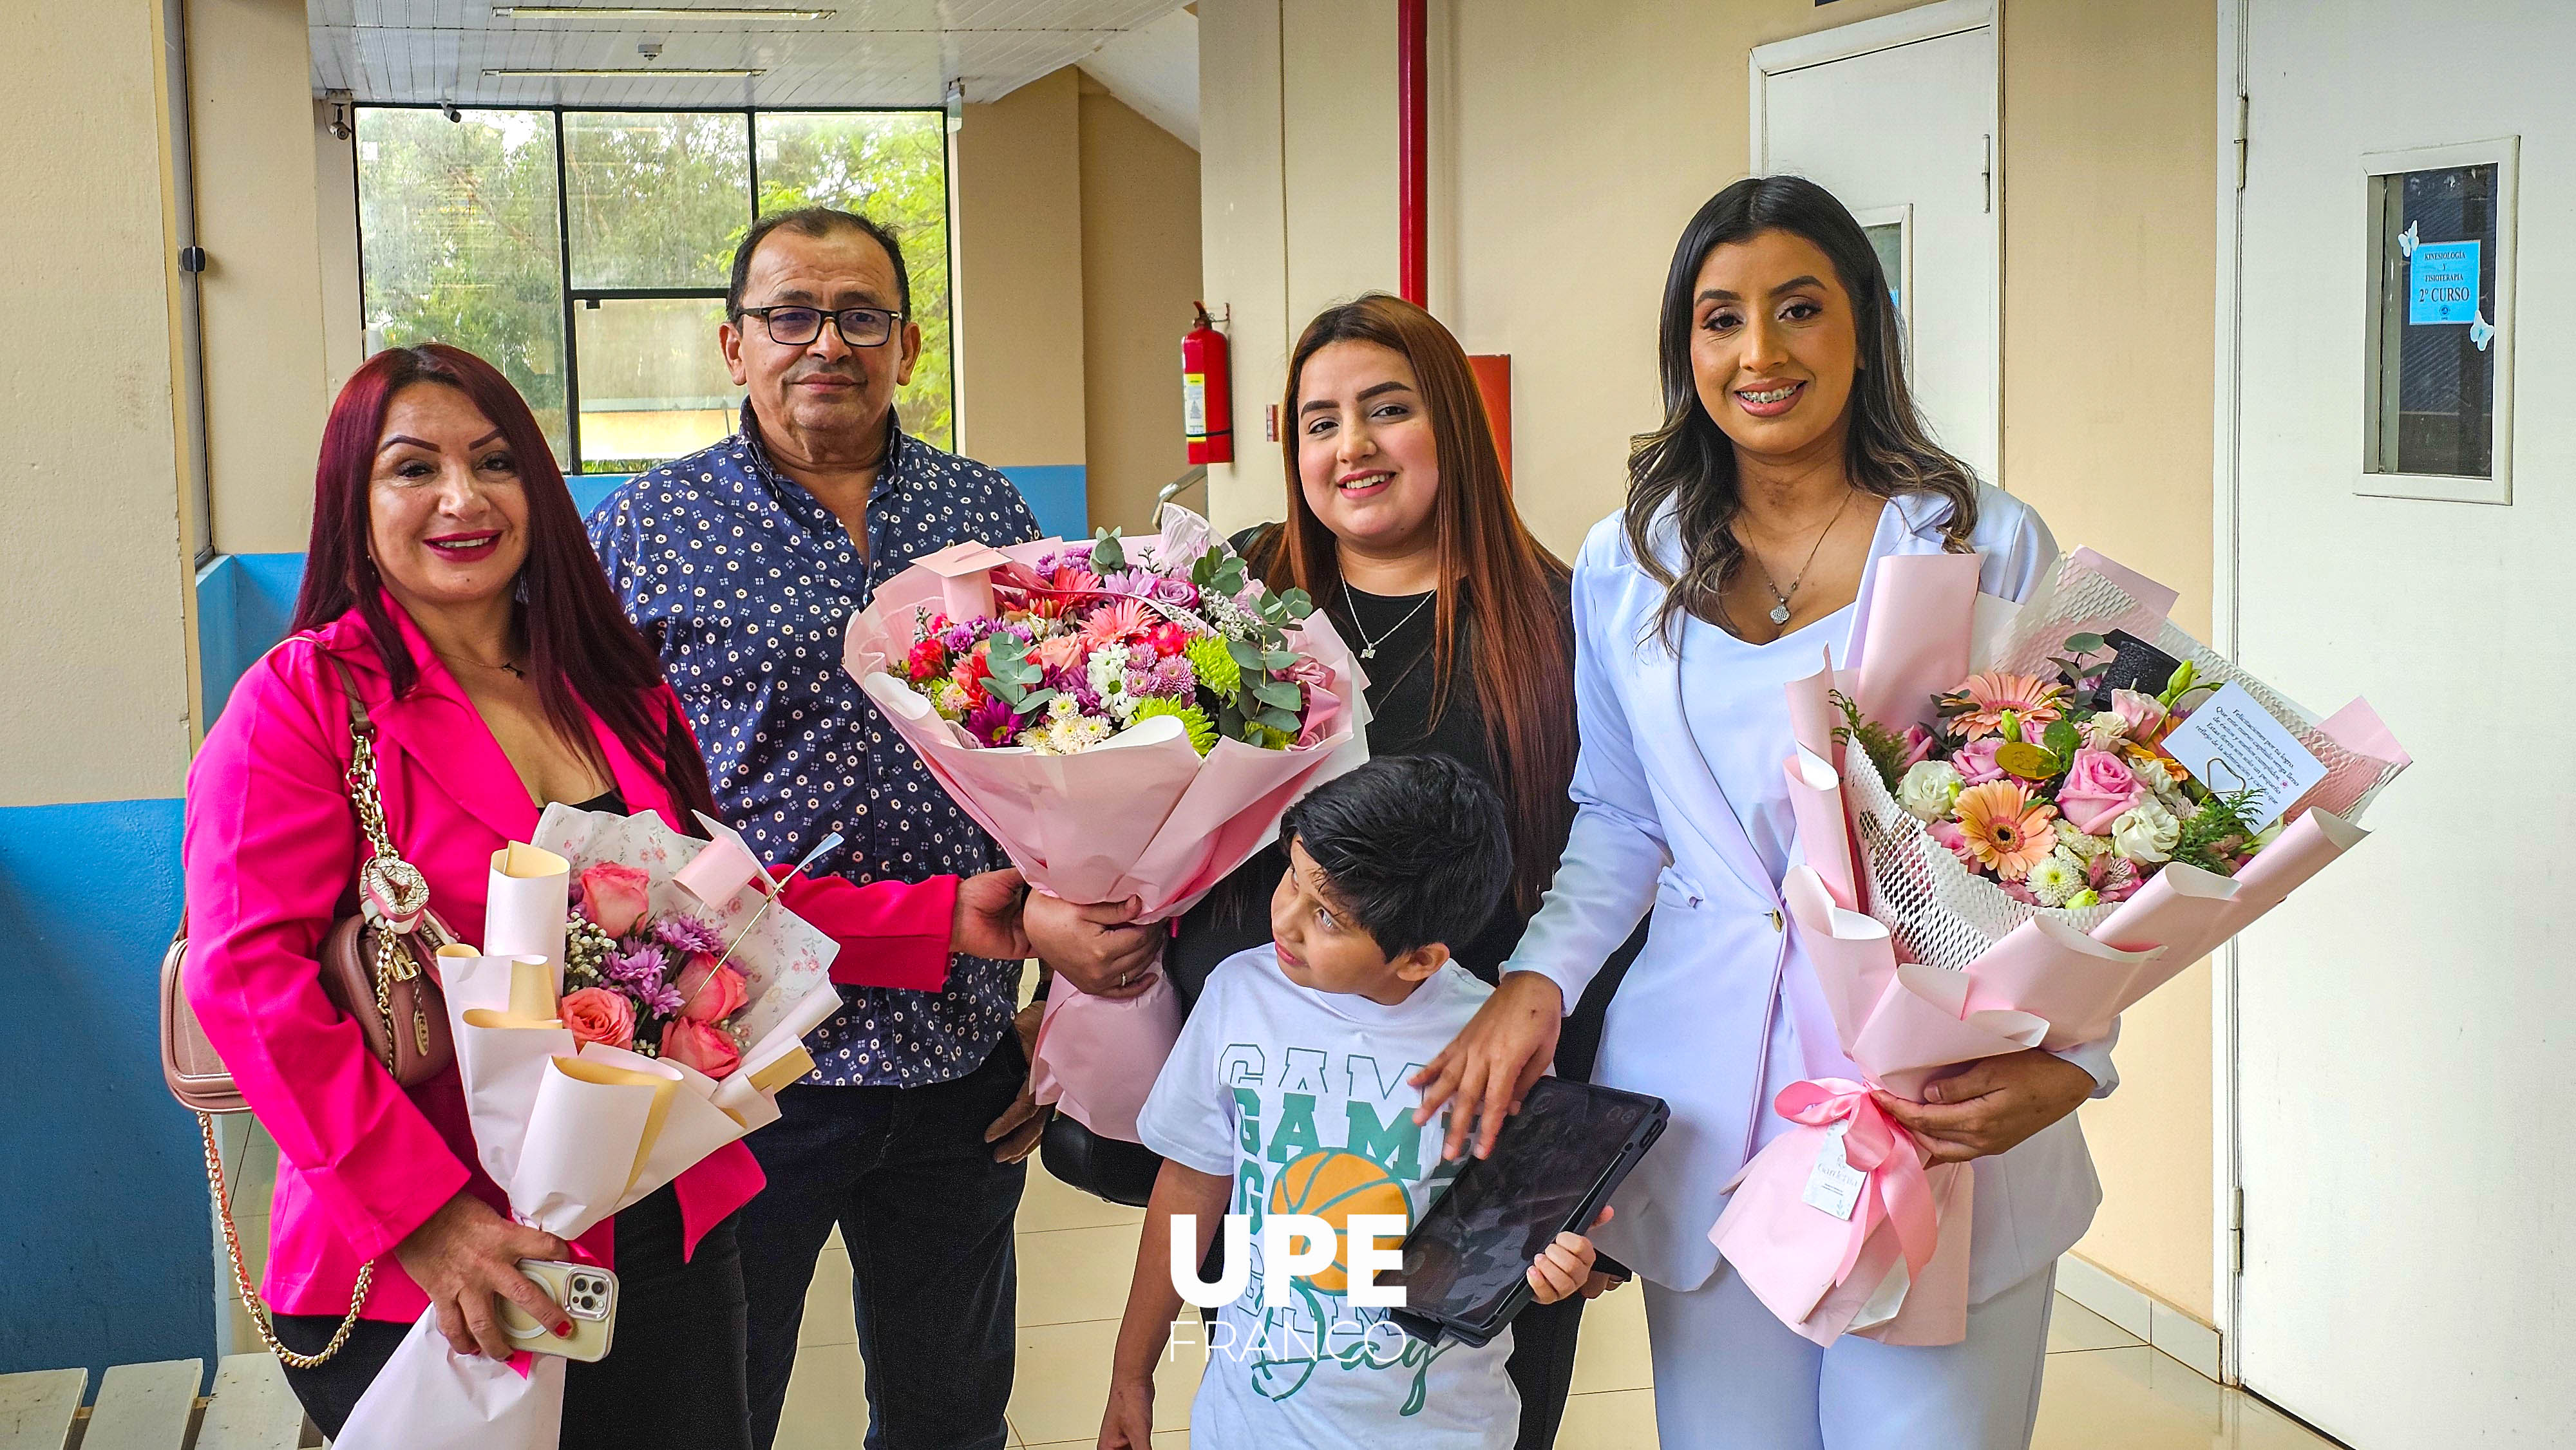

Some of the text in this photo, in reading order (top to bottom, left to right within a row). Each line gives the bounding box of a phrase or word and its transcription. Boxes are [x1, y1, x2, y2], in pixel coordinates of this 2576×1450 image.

[2431, 287, 2470, 302] CURSO
[2212, 716, 2221, 724] de
[2206, 722, 2221, 736] Estas
[2216, 706, 2228, 719] Que
[2286, 772, 2299, 786] lleno
[2264, 740, 2276, 749] por
[2195, 725, 2213, 740] reflejo
[2211, 739, 2219, 748] de
[2253, 780, 2269, 796] caro
[2268, 795, 2278, 805] que
[1218, 1044, 1427, 1100] GAM
